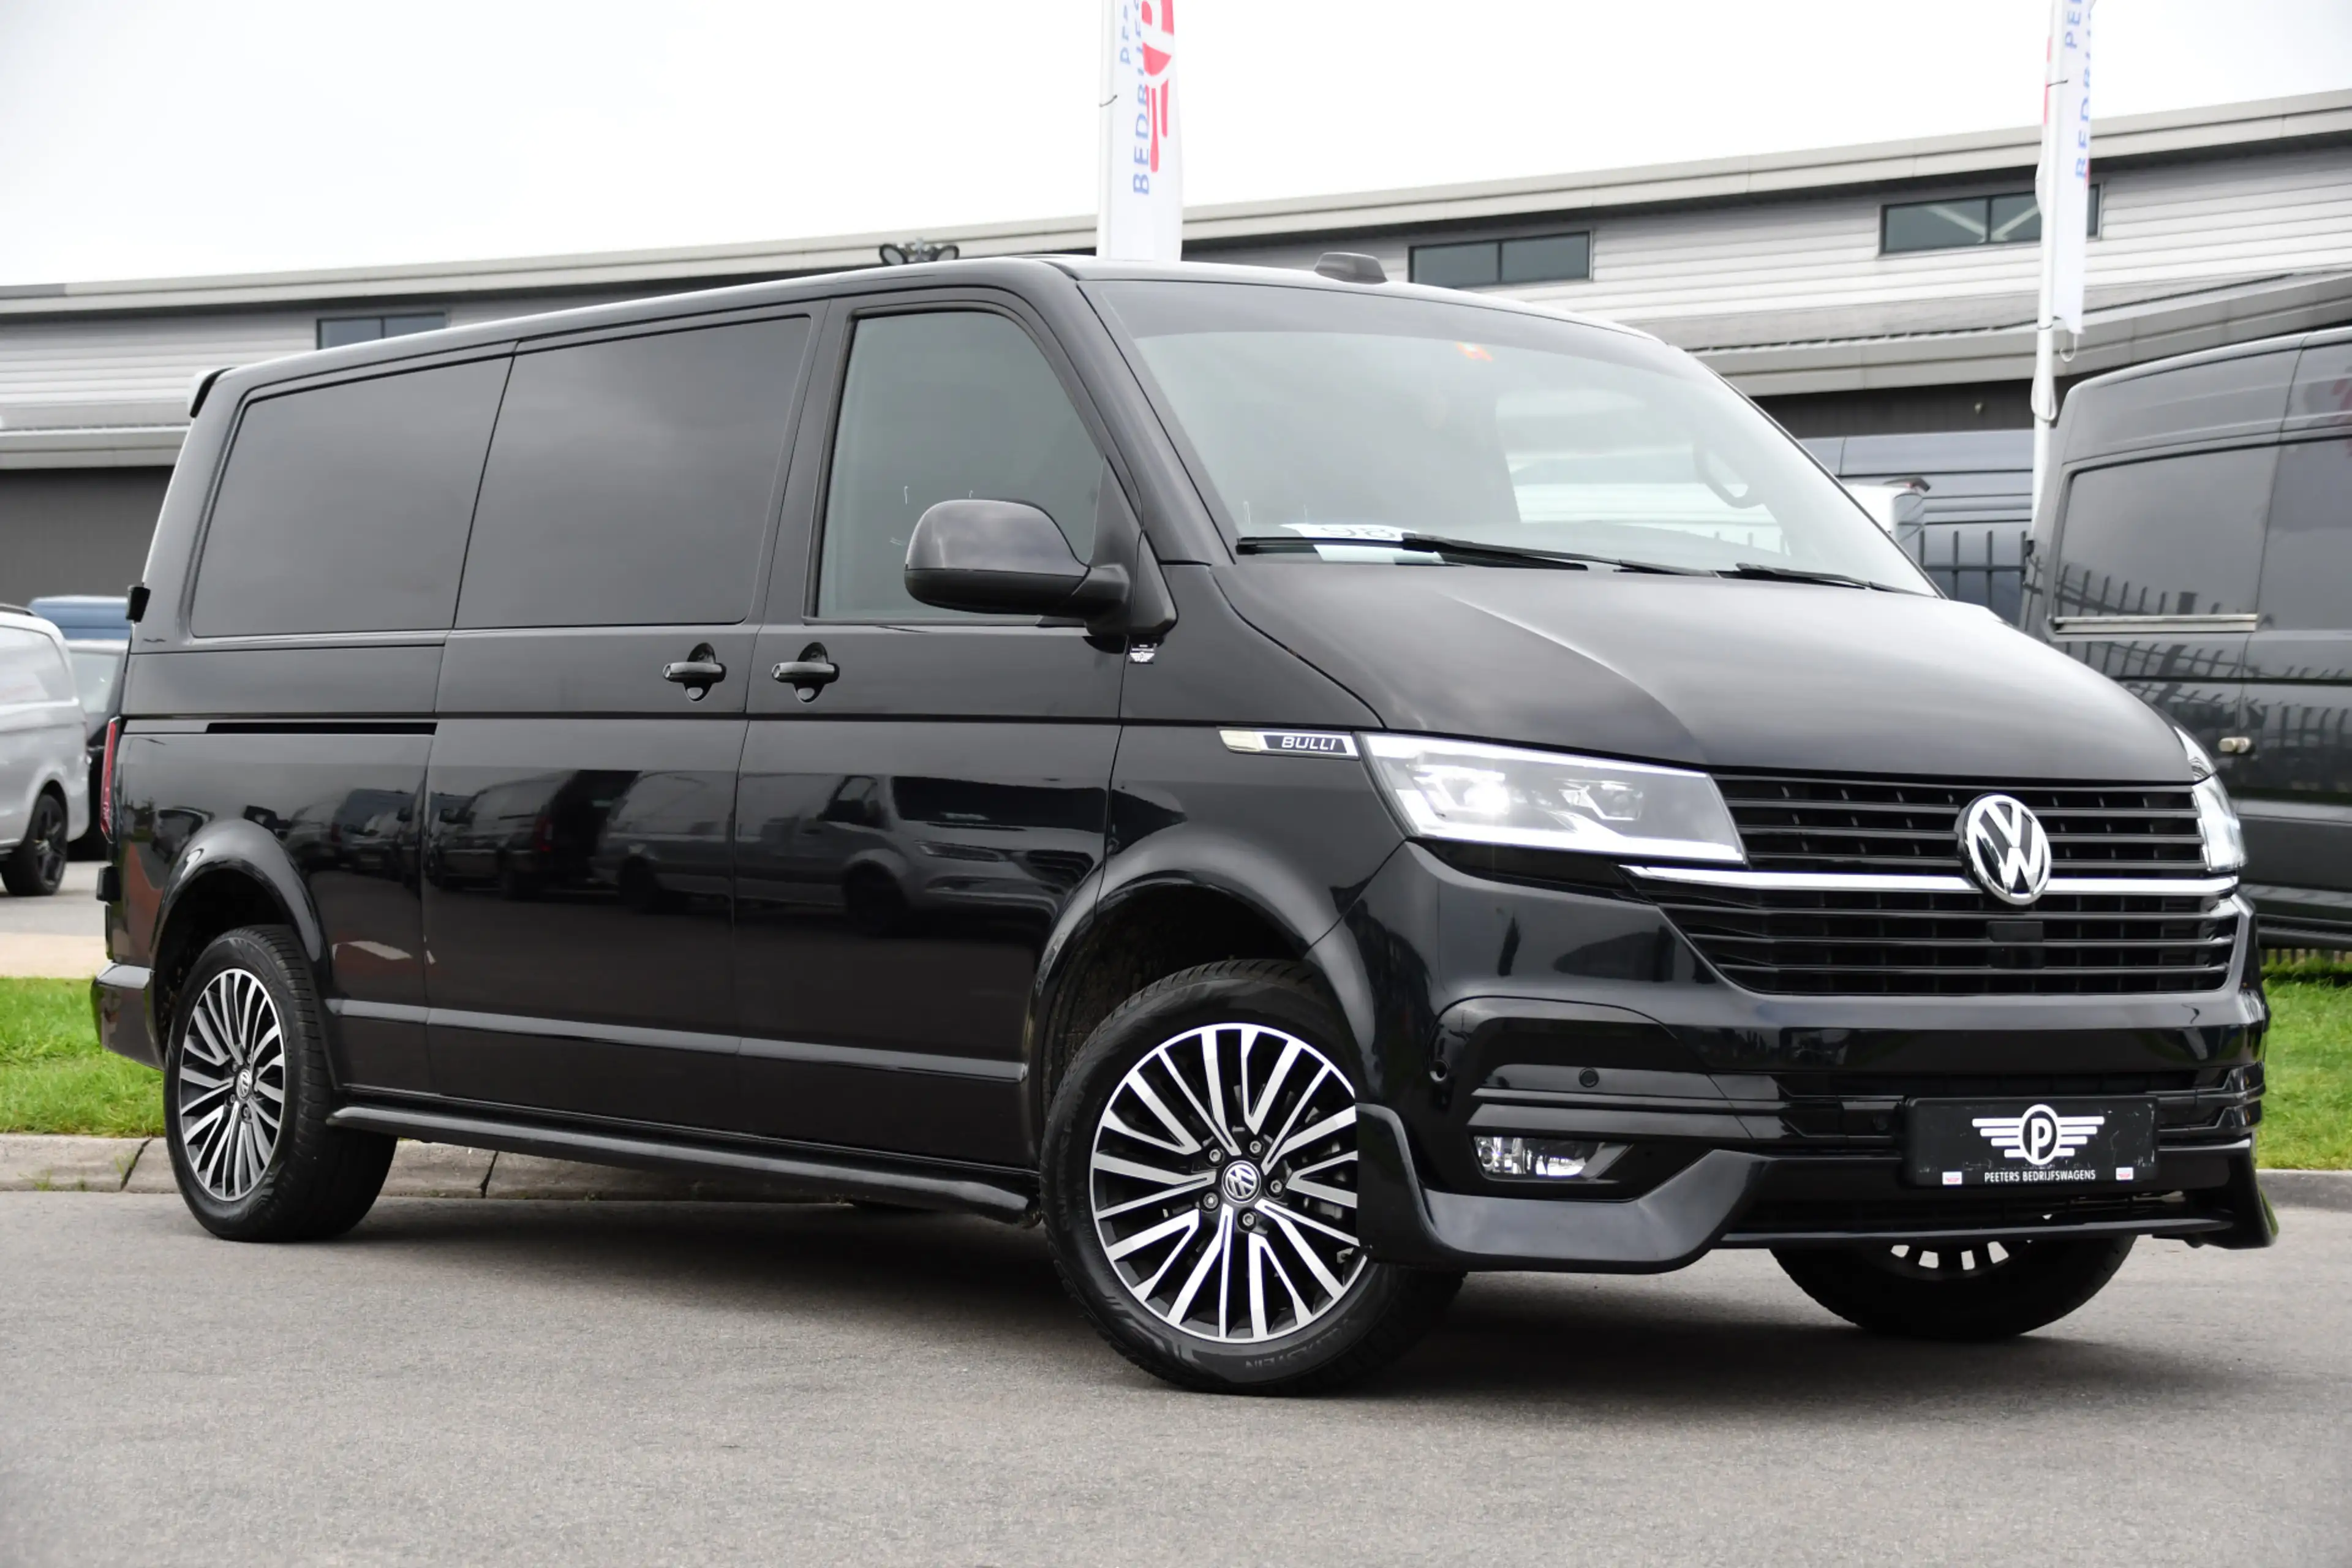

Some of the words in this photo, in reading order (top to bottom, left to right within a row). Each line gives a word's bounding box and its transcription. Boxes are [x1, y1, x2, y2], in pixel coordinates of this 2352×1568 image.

[1281, 736, 1336, 750] BULLI
[1984, 1172, 2020, 1183] PEETERS
[2022, 1169, 2096, 1182] BEDRIJFSWAGENS
